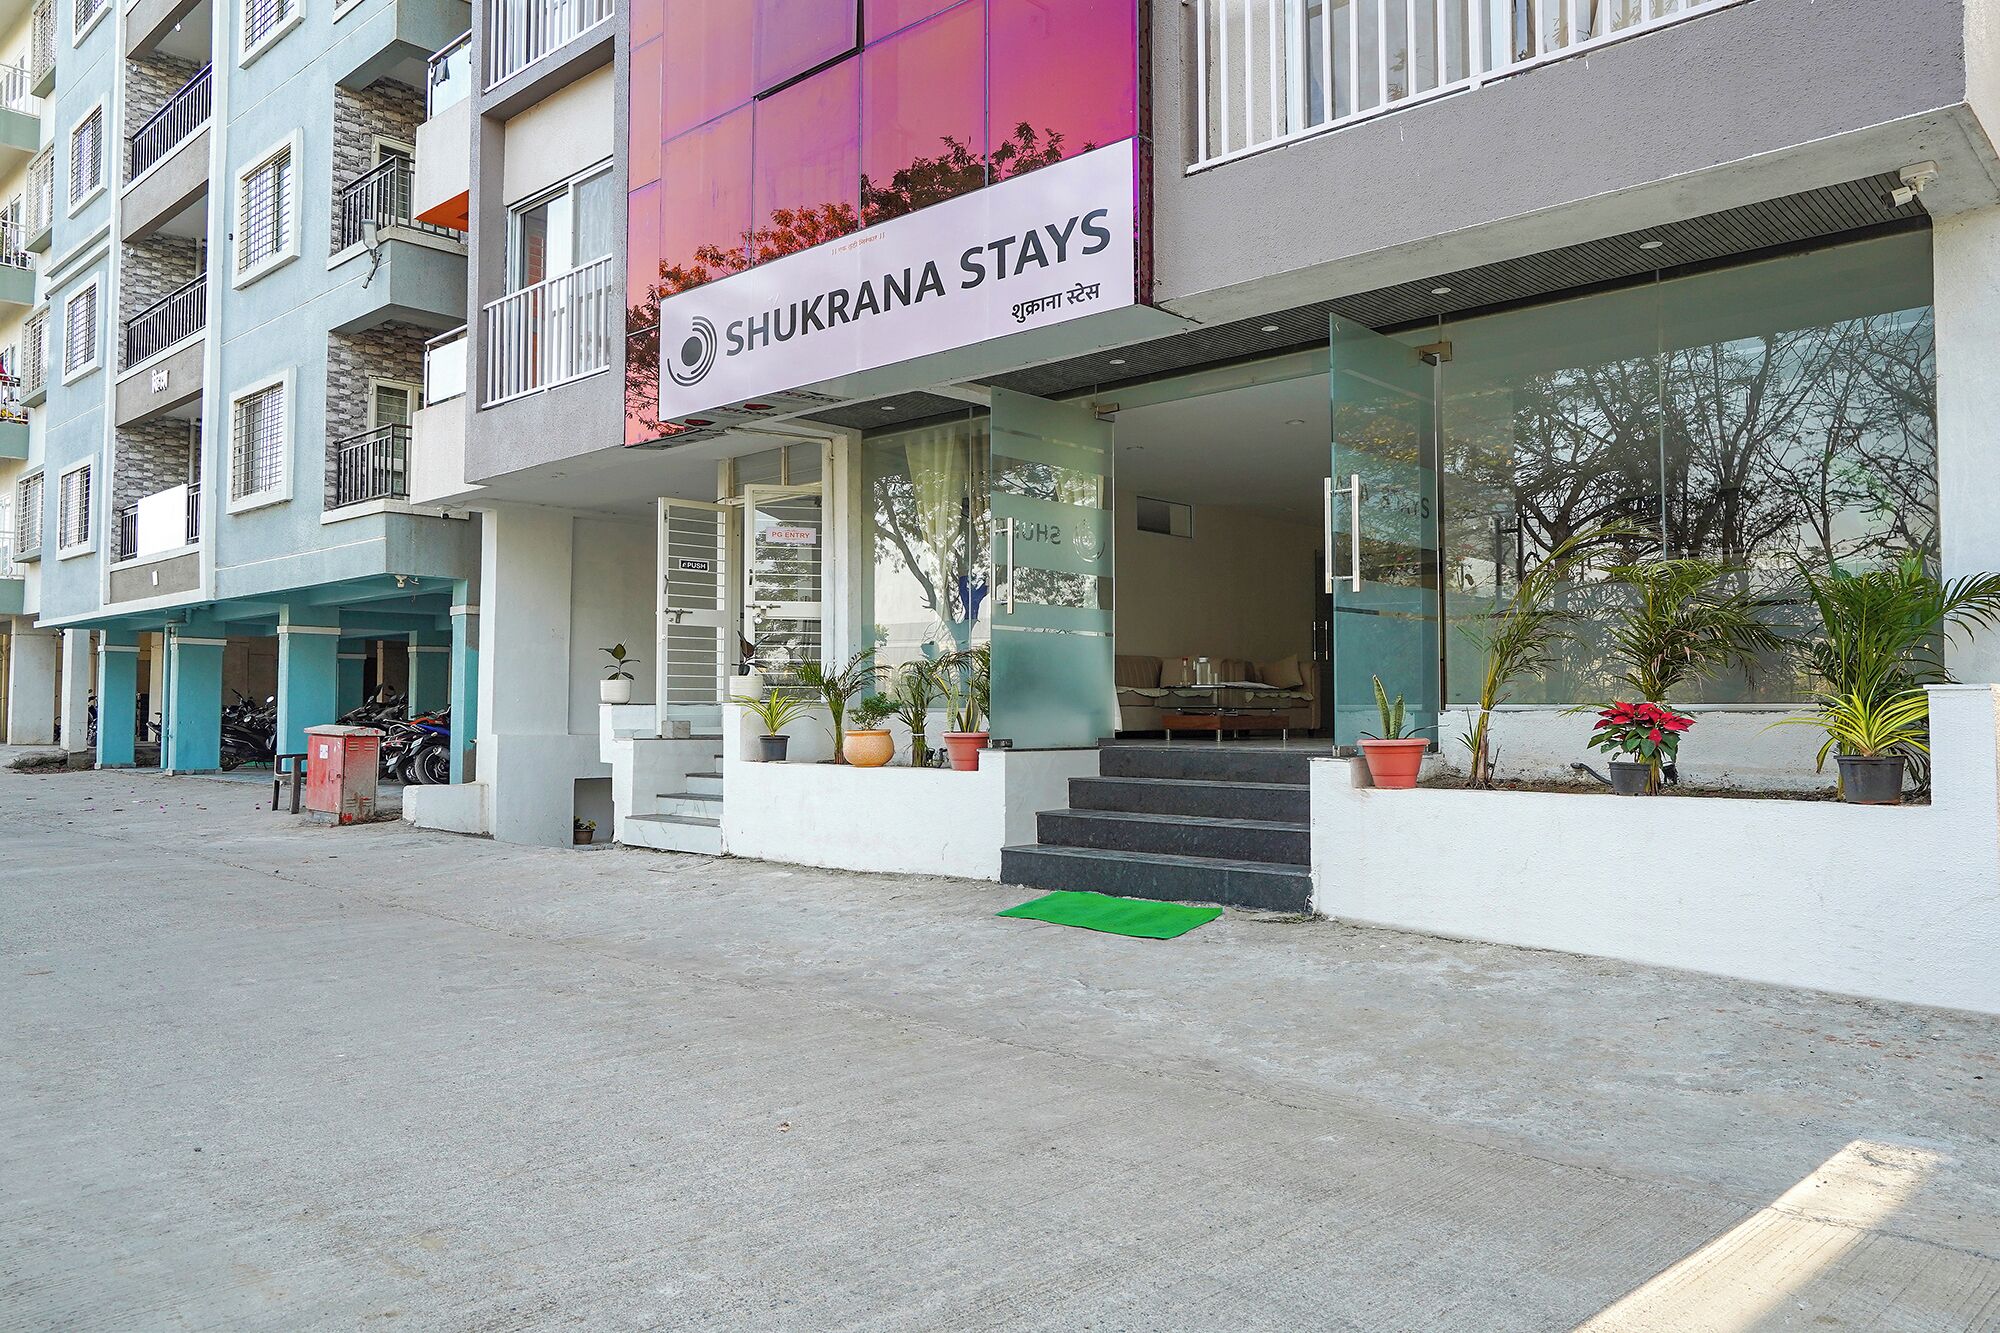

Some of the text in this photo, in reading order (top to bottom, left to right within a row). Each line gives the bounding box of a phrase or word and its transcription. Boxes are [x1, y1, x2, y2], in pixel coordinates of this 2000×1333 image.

[726, 208, 1111, 357] SHUKRANA STAYS
[1011, 282, 1101, 323] शुक्राना स्टेस
[686, 561, 706, 570] PUSH
